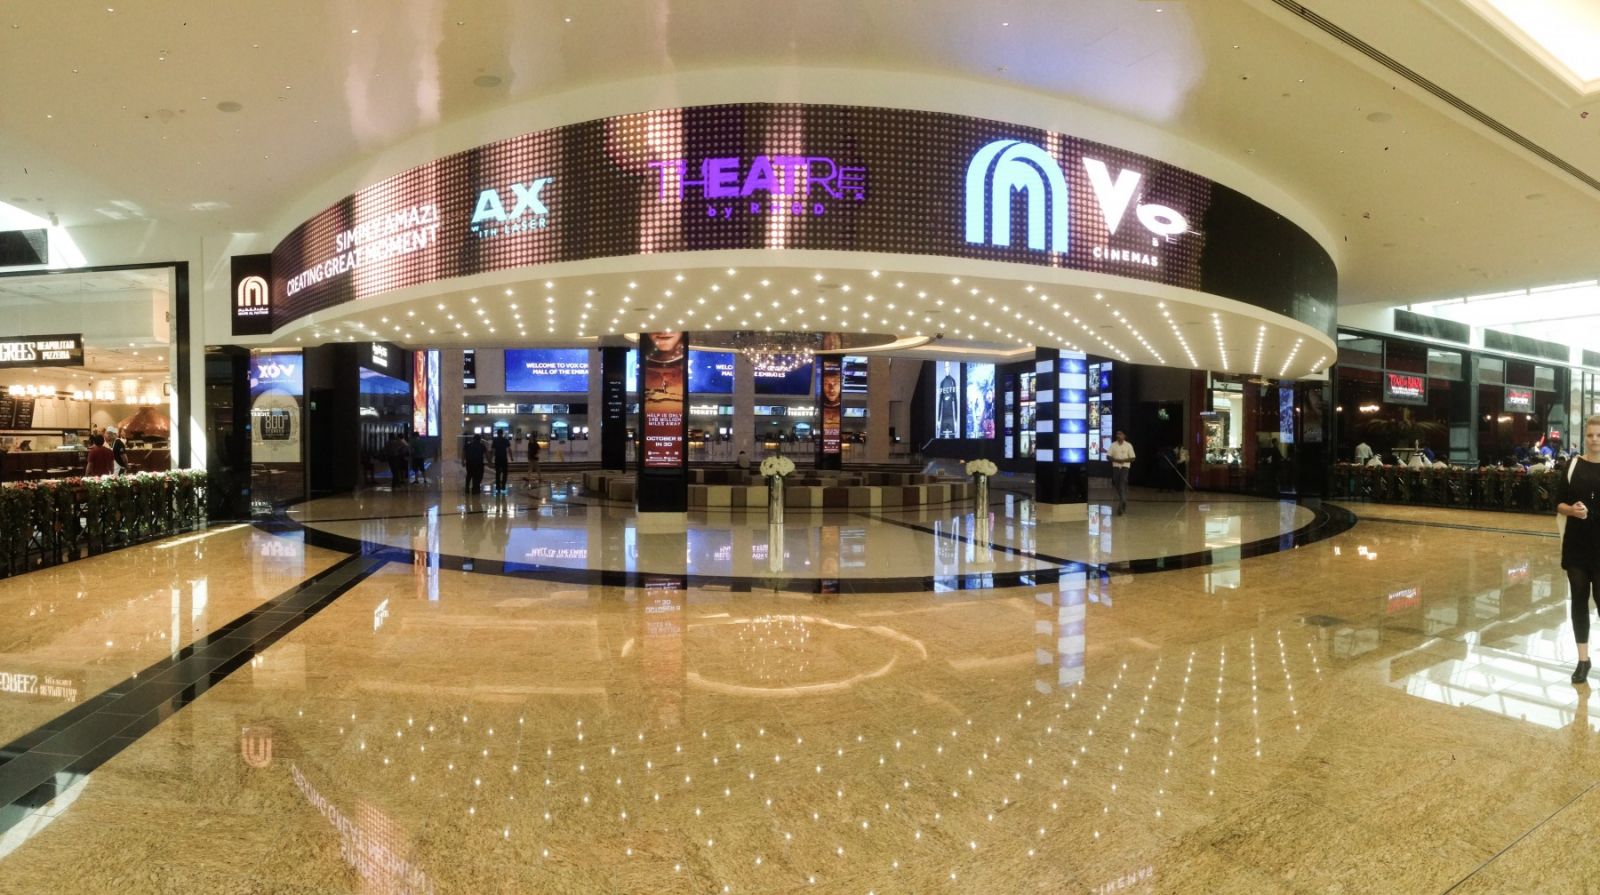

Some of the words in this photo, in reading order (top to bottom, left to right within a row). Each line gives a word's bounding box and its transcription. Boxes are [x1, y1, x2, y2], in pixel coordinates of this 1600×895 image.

[648, 154, 866, 201] THEATRE
[504, 218, 546, 234] LASER
[286, 266, 323, 297] CREATING
[324, 250, 362, 279] GREAT
[1092, 246, 1158, 267] CINEMAS
